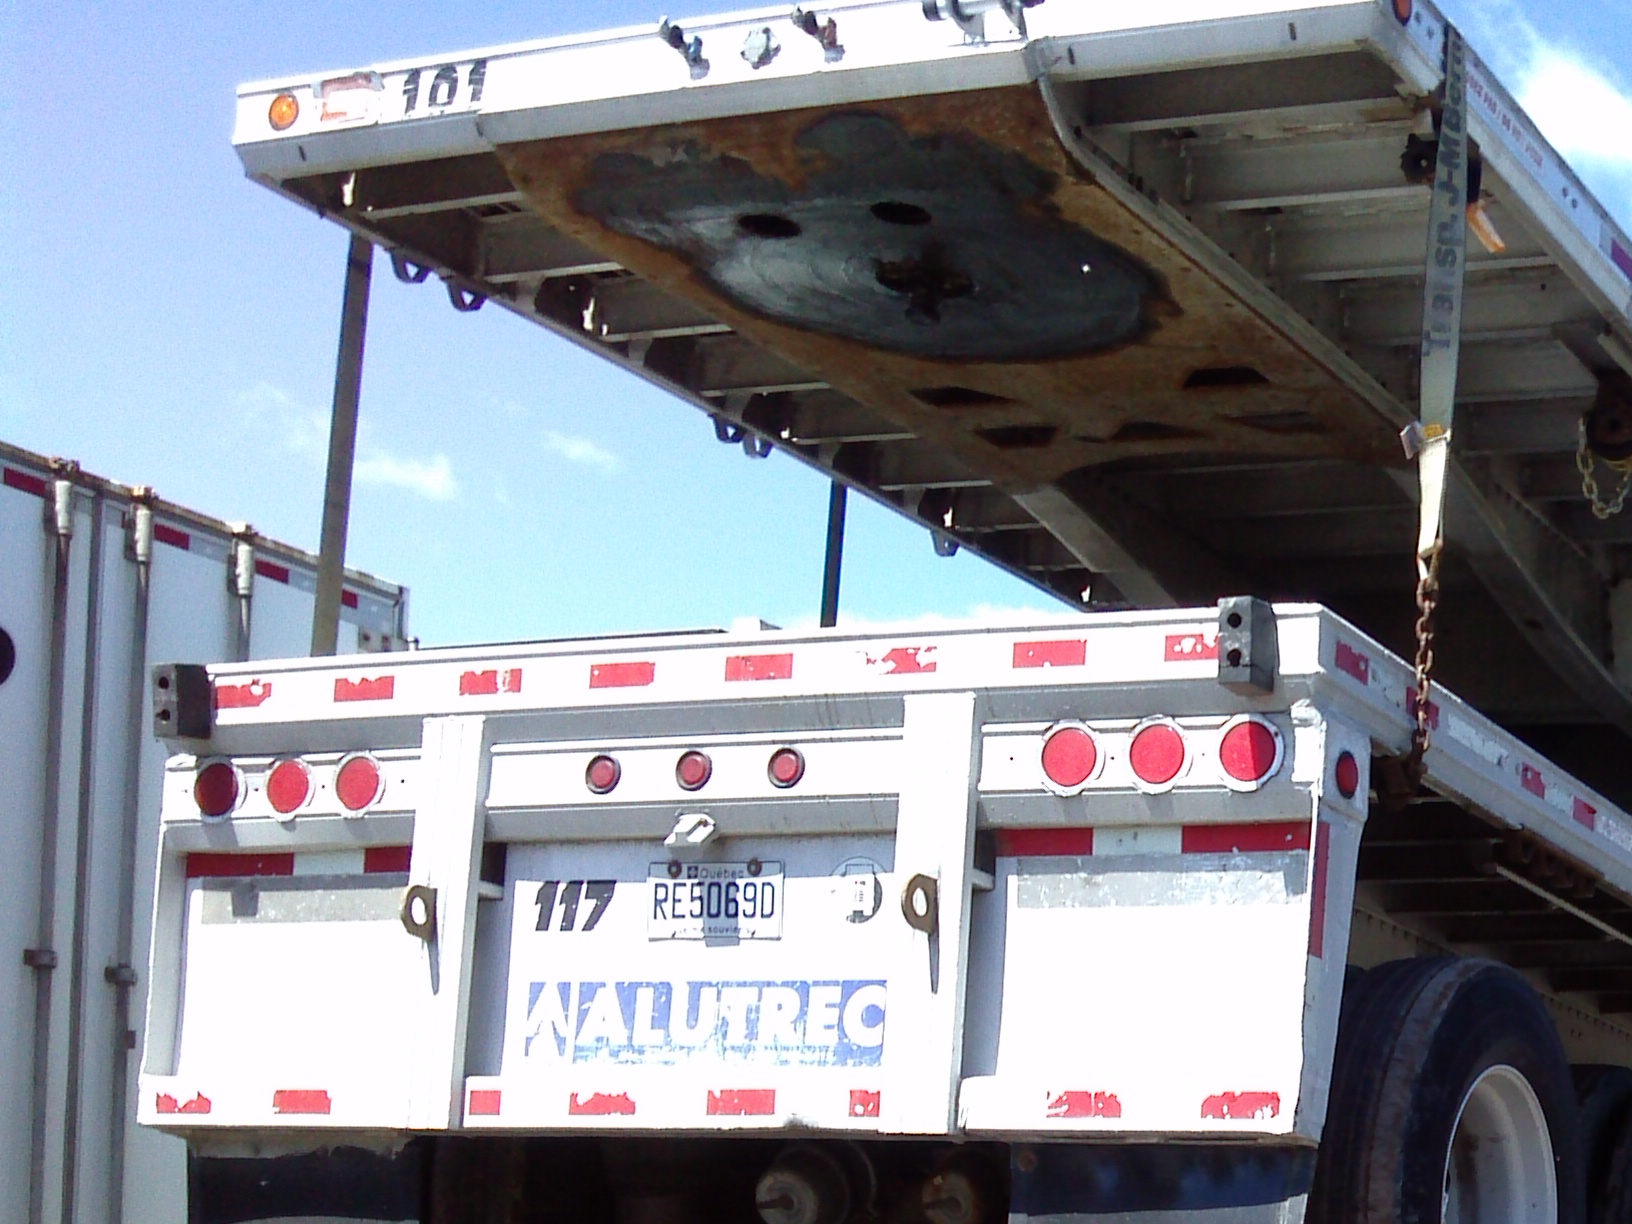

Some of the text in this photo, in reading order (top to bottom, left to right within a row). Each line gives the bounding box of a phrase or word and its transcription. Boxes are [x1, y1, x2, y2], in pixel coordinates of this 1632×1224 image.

[403, 58, 487, 114] 101
[700, 866, 744, 879] Québec
[535, 880, 617, 931] 117
[653, 881, 775, 920] RE5069D
[708, 925, 751, 935] souvie
